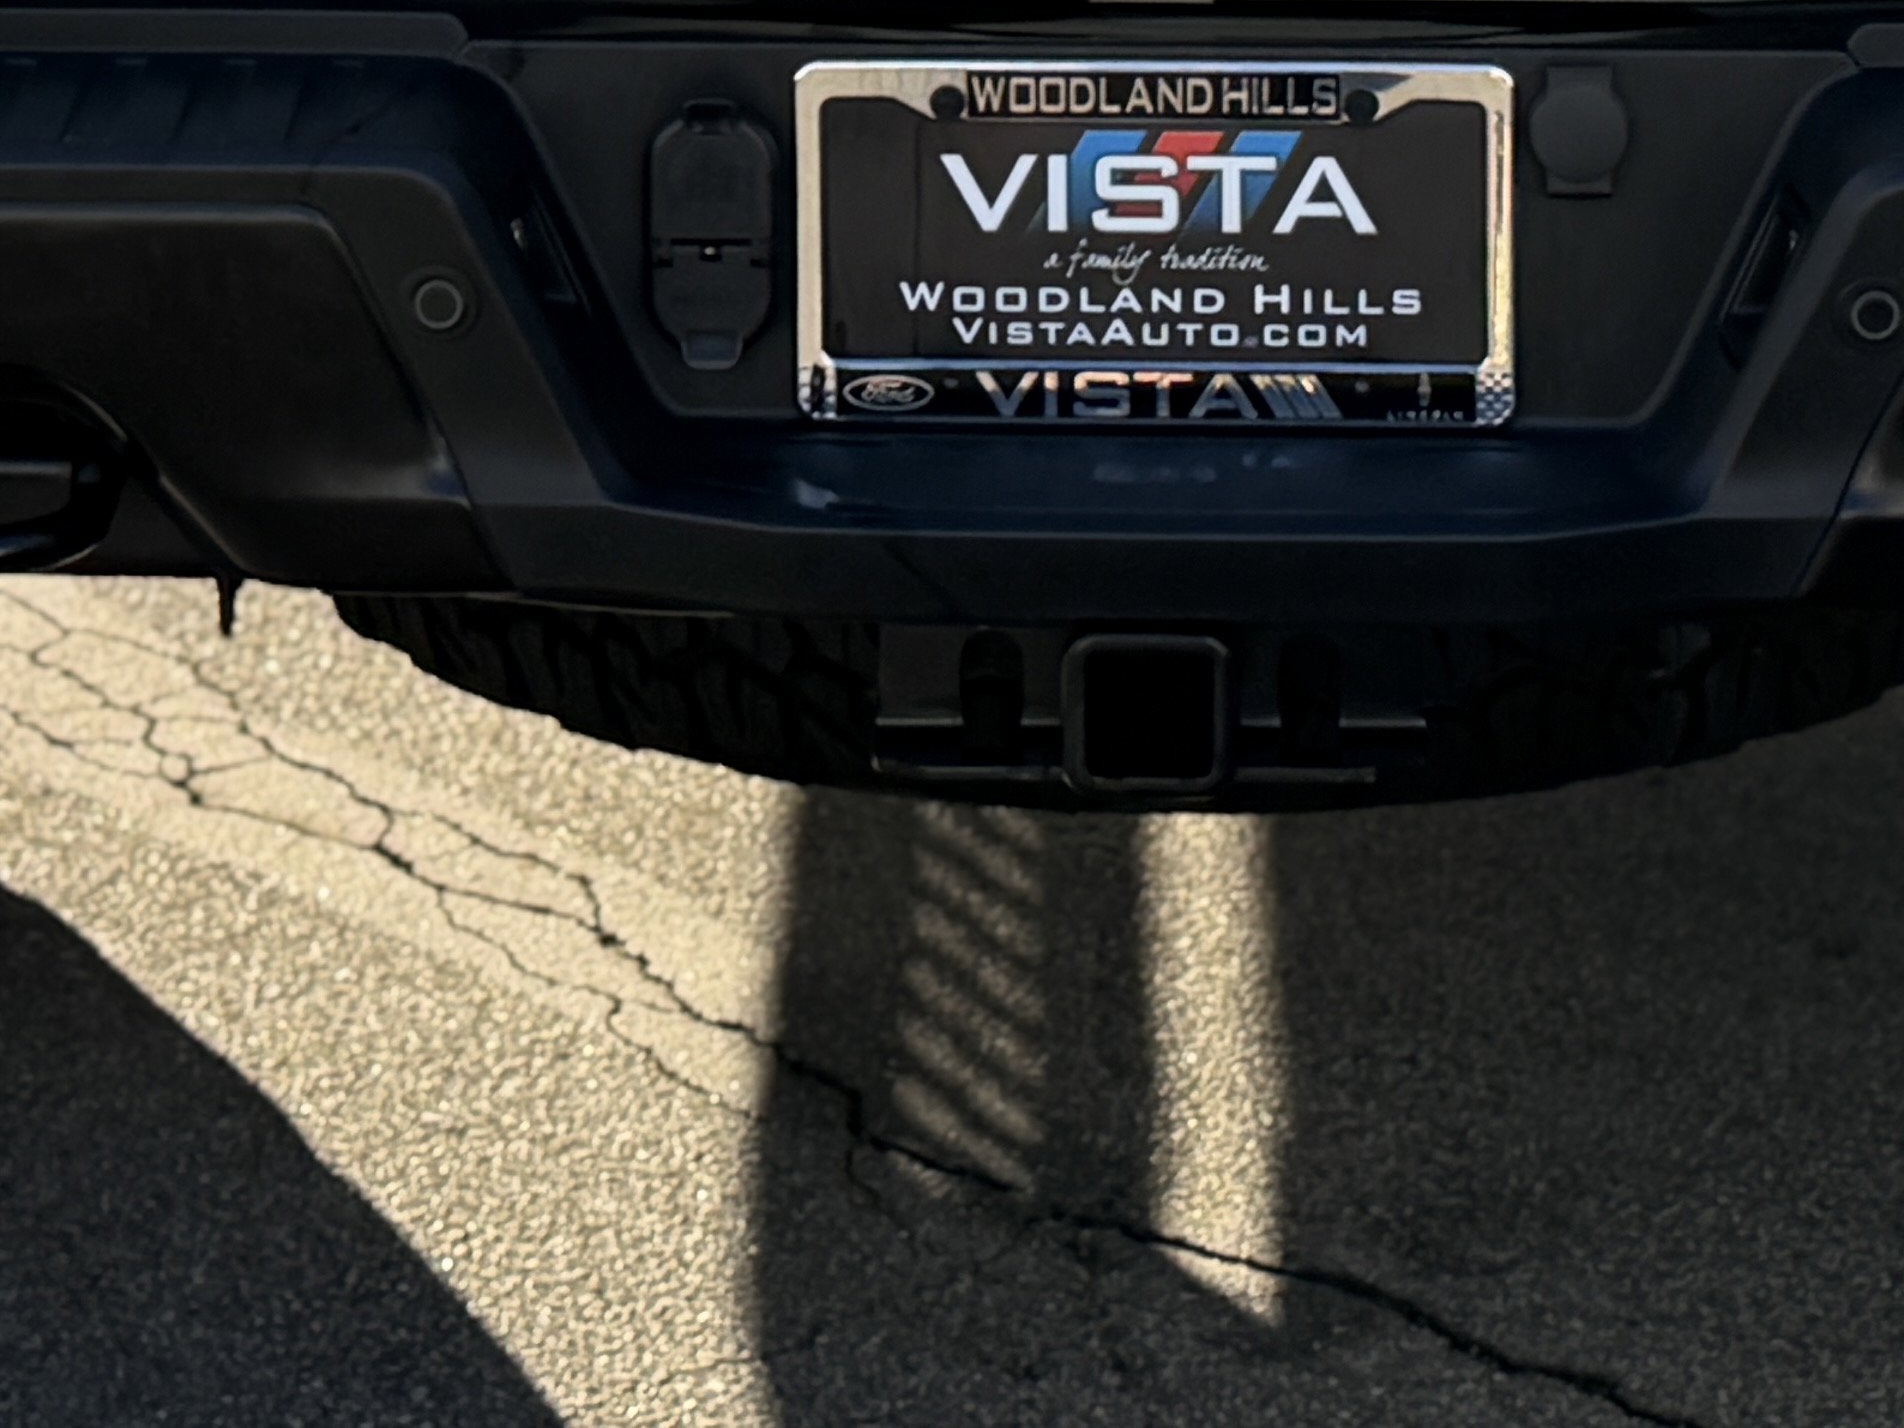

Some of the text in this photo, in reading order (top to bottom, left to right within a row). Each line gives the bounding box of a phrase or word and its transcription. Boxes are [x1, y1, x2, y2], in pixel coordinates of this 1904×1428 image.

[971, 76, 1337, 116] WOODLAND HILLS
[939, 154, 1378, 235] VISTA
[1065, 238, 1152, 286] family
[1160, 244, 1270, 272] tradition
[975, 370, 1259, 419] VISTA
